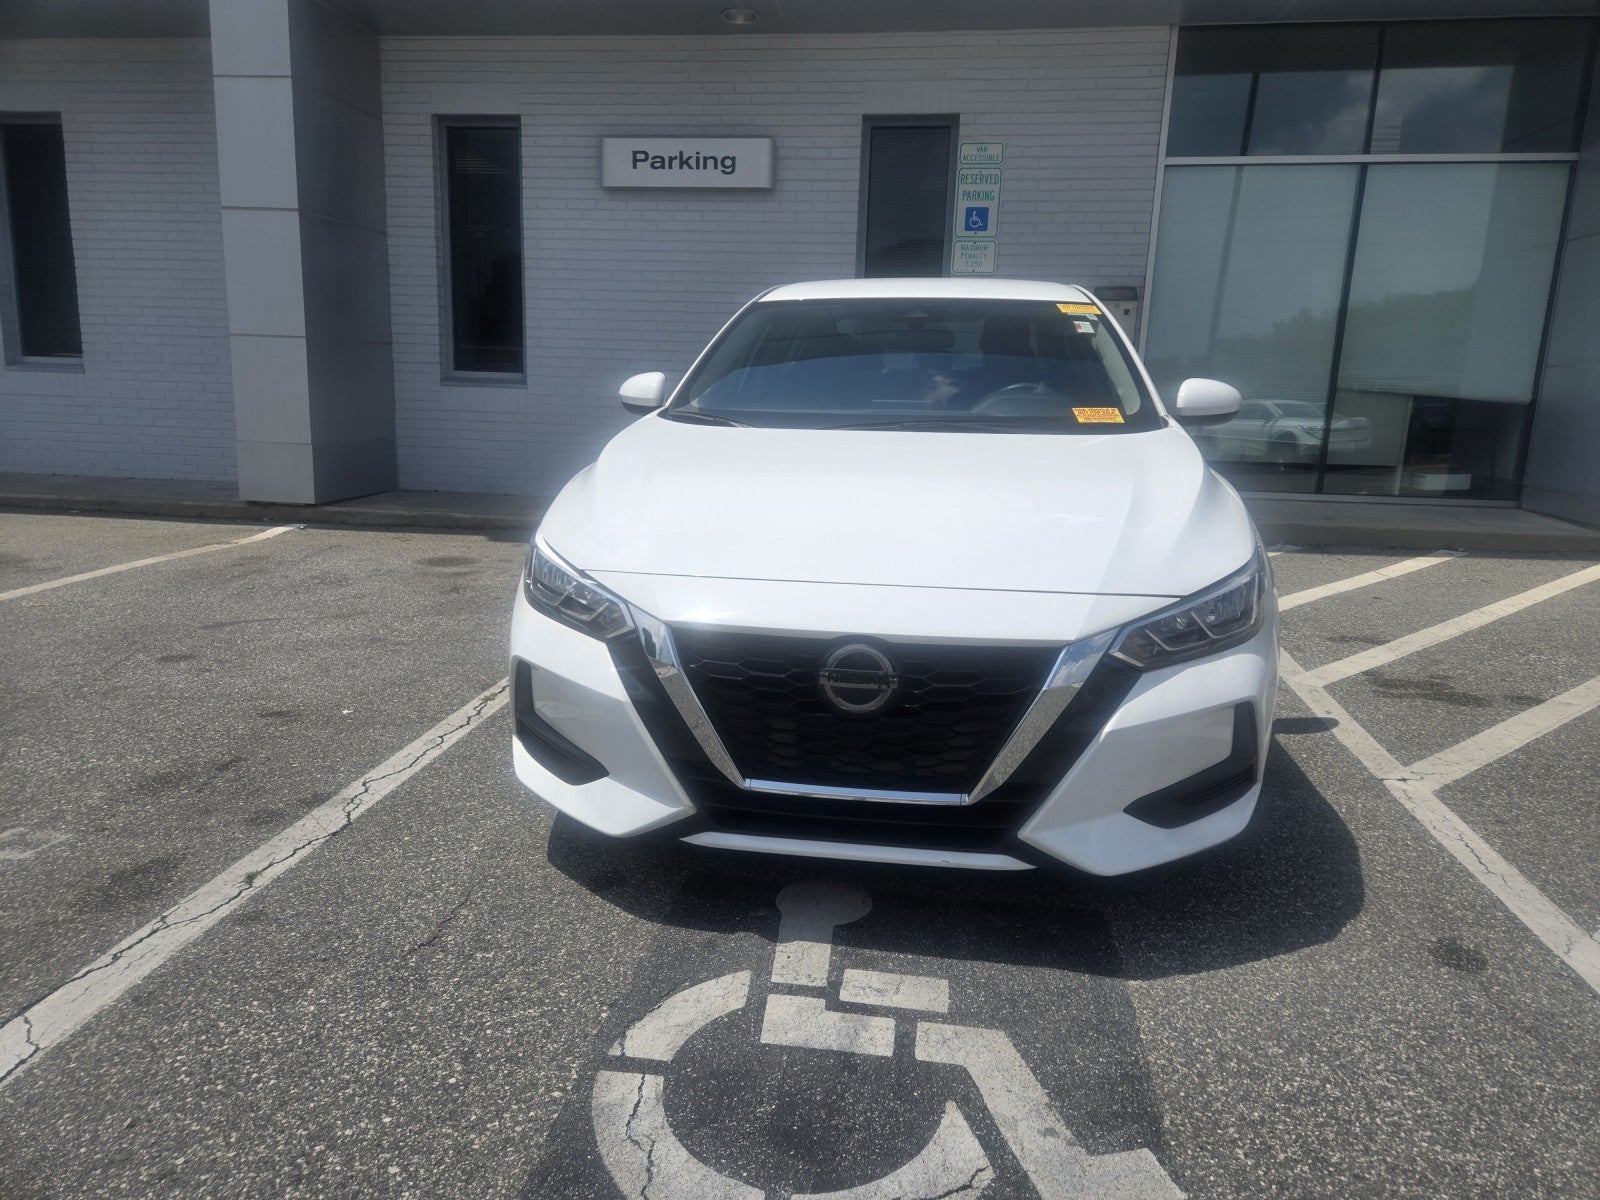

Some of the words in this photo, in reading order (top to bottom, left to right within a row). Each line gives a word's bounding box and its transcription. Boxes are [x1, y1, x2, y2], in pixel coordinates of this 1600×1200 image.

[632, 150, 737, 175] Parking
[962, 154, 1001, 162] ACCESSIBLE
[960, 173, 1000, 185] RESERVED
[962, 190, 996, 201] PARKING
[960, 252, 987, 260] PENALTY
